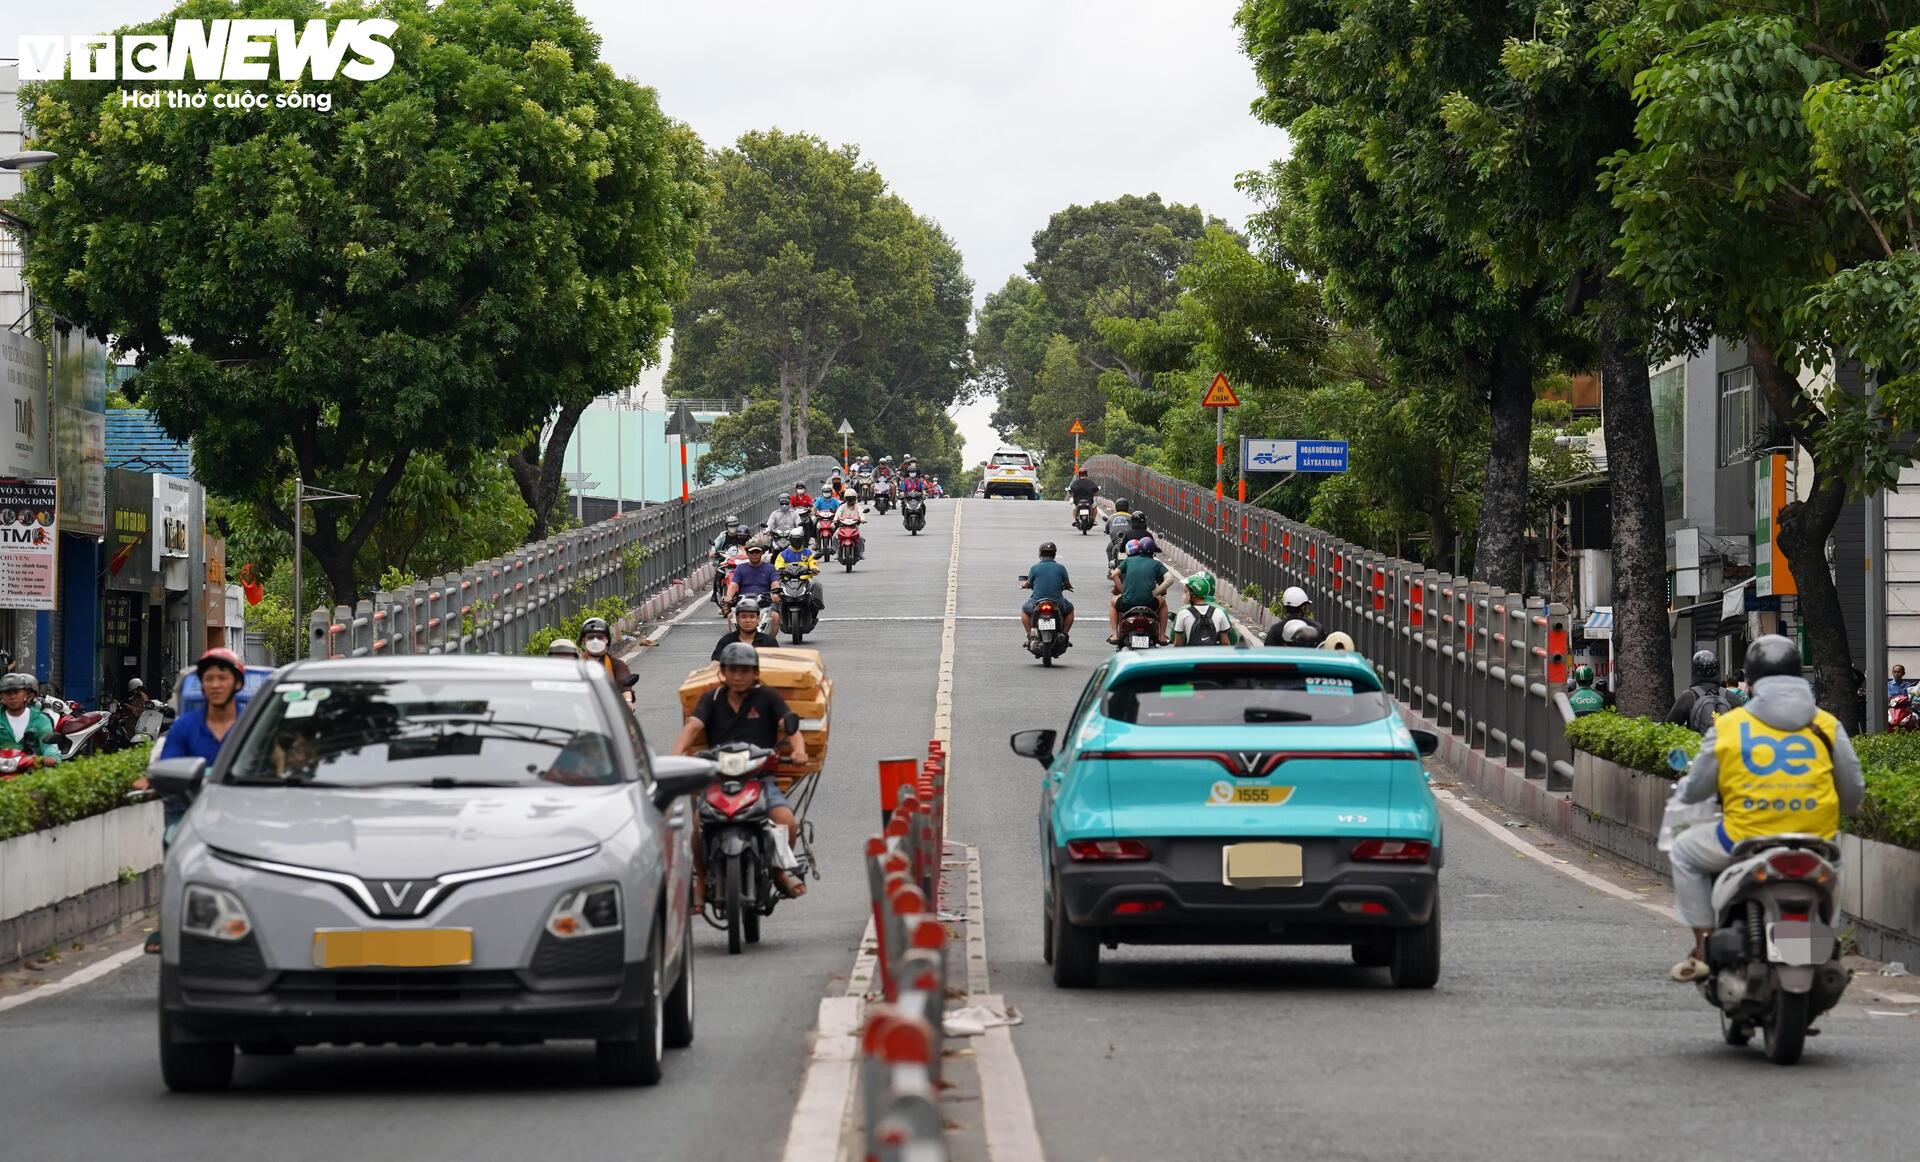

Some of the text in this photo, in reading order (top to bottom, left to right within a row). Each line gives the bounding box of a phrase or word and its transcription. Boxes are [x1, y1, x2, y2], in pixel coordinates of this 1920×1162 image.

[14, 487, 26, 495] XE
[1, 528, 31, 543] TM
[1575, 696, 1598, 705] Grab
[1740, 721, 1816, 775] be
[1237, 788, 1270, 802] 1555
